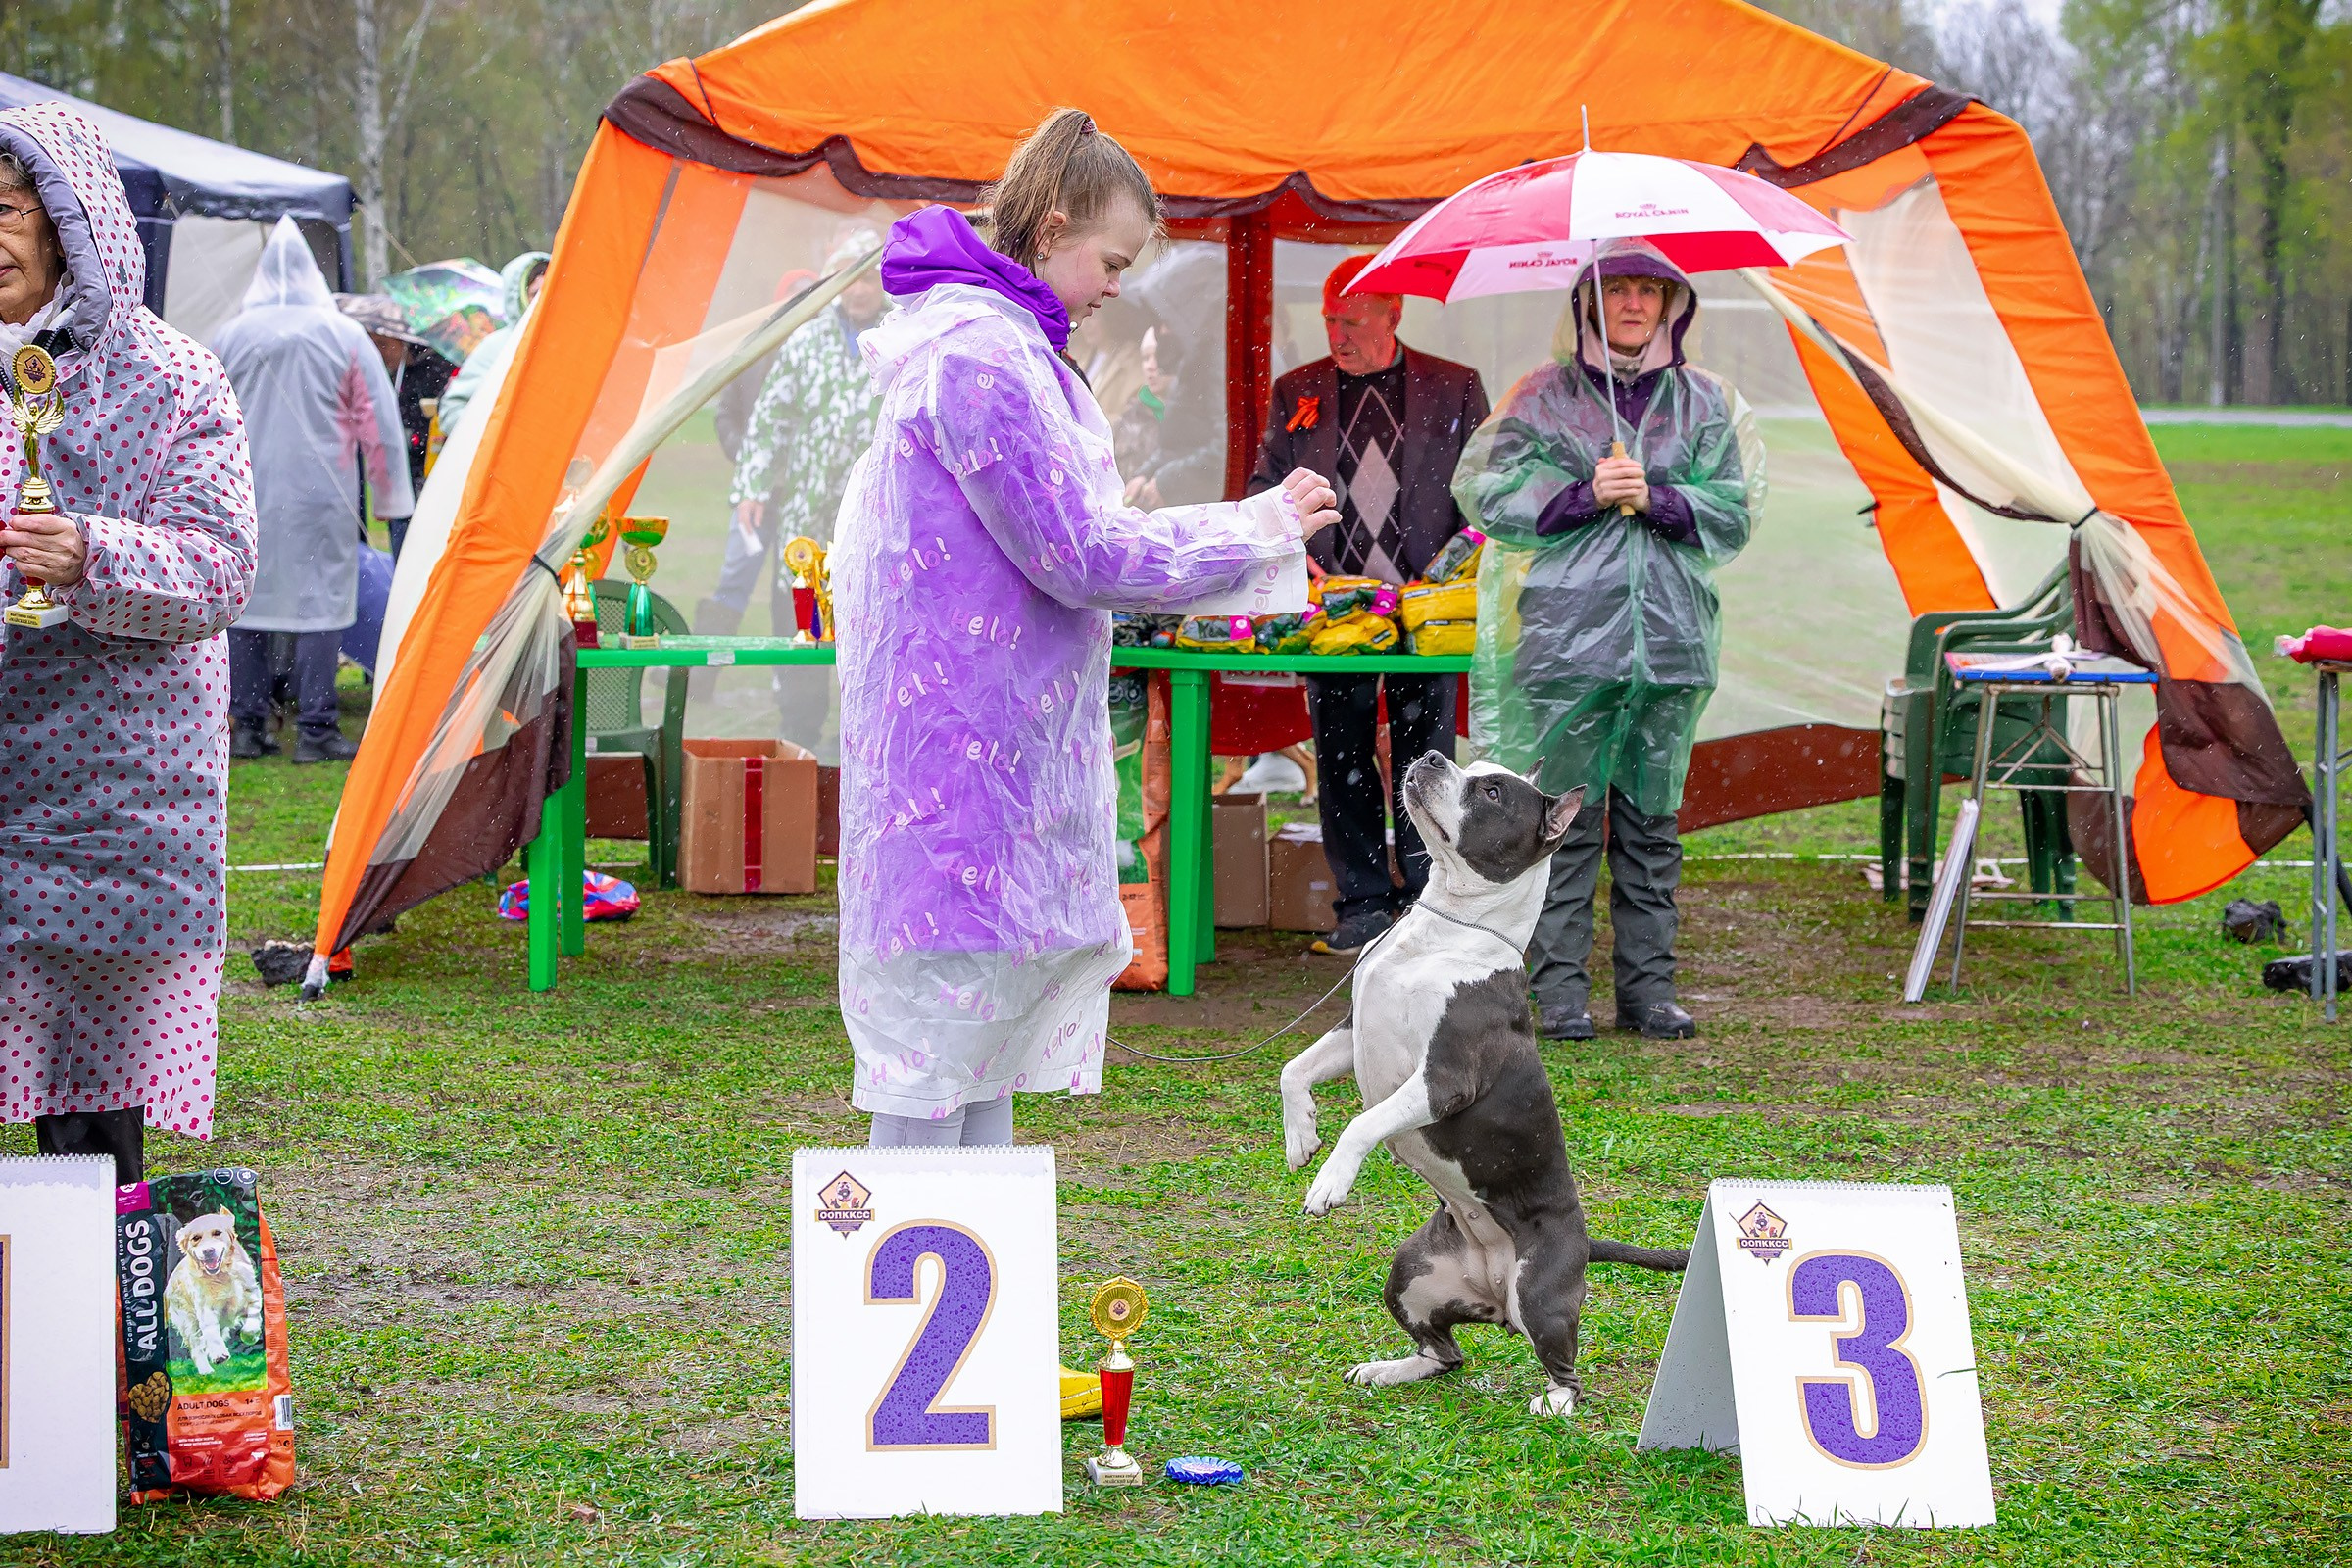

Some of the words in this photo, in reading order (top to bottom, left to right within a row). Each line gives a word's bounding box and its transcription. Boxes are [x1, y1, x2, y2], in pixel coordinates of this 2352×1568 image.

[950, 607, 1022, 650] Hello!
[948, 732, 1022, 773] Hello!
[125, 1219, 156, 1298] DOGS
[135, 1300, 158, 1351] ALL
[863, 1218, 998, 1452] 2
[1786, 1249, 1929, 1470] 3
[177, 1402, 204, 1411] ADULT
[206, 1399, 230, 1408] DOGS
